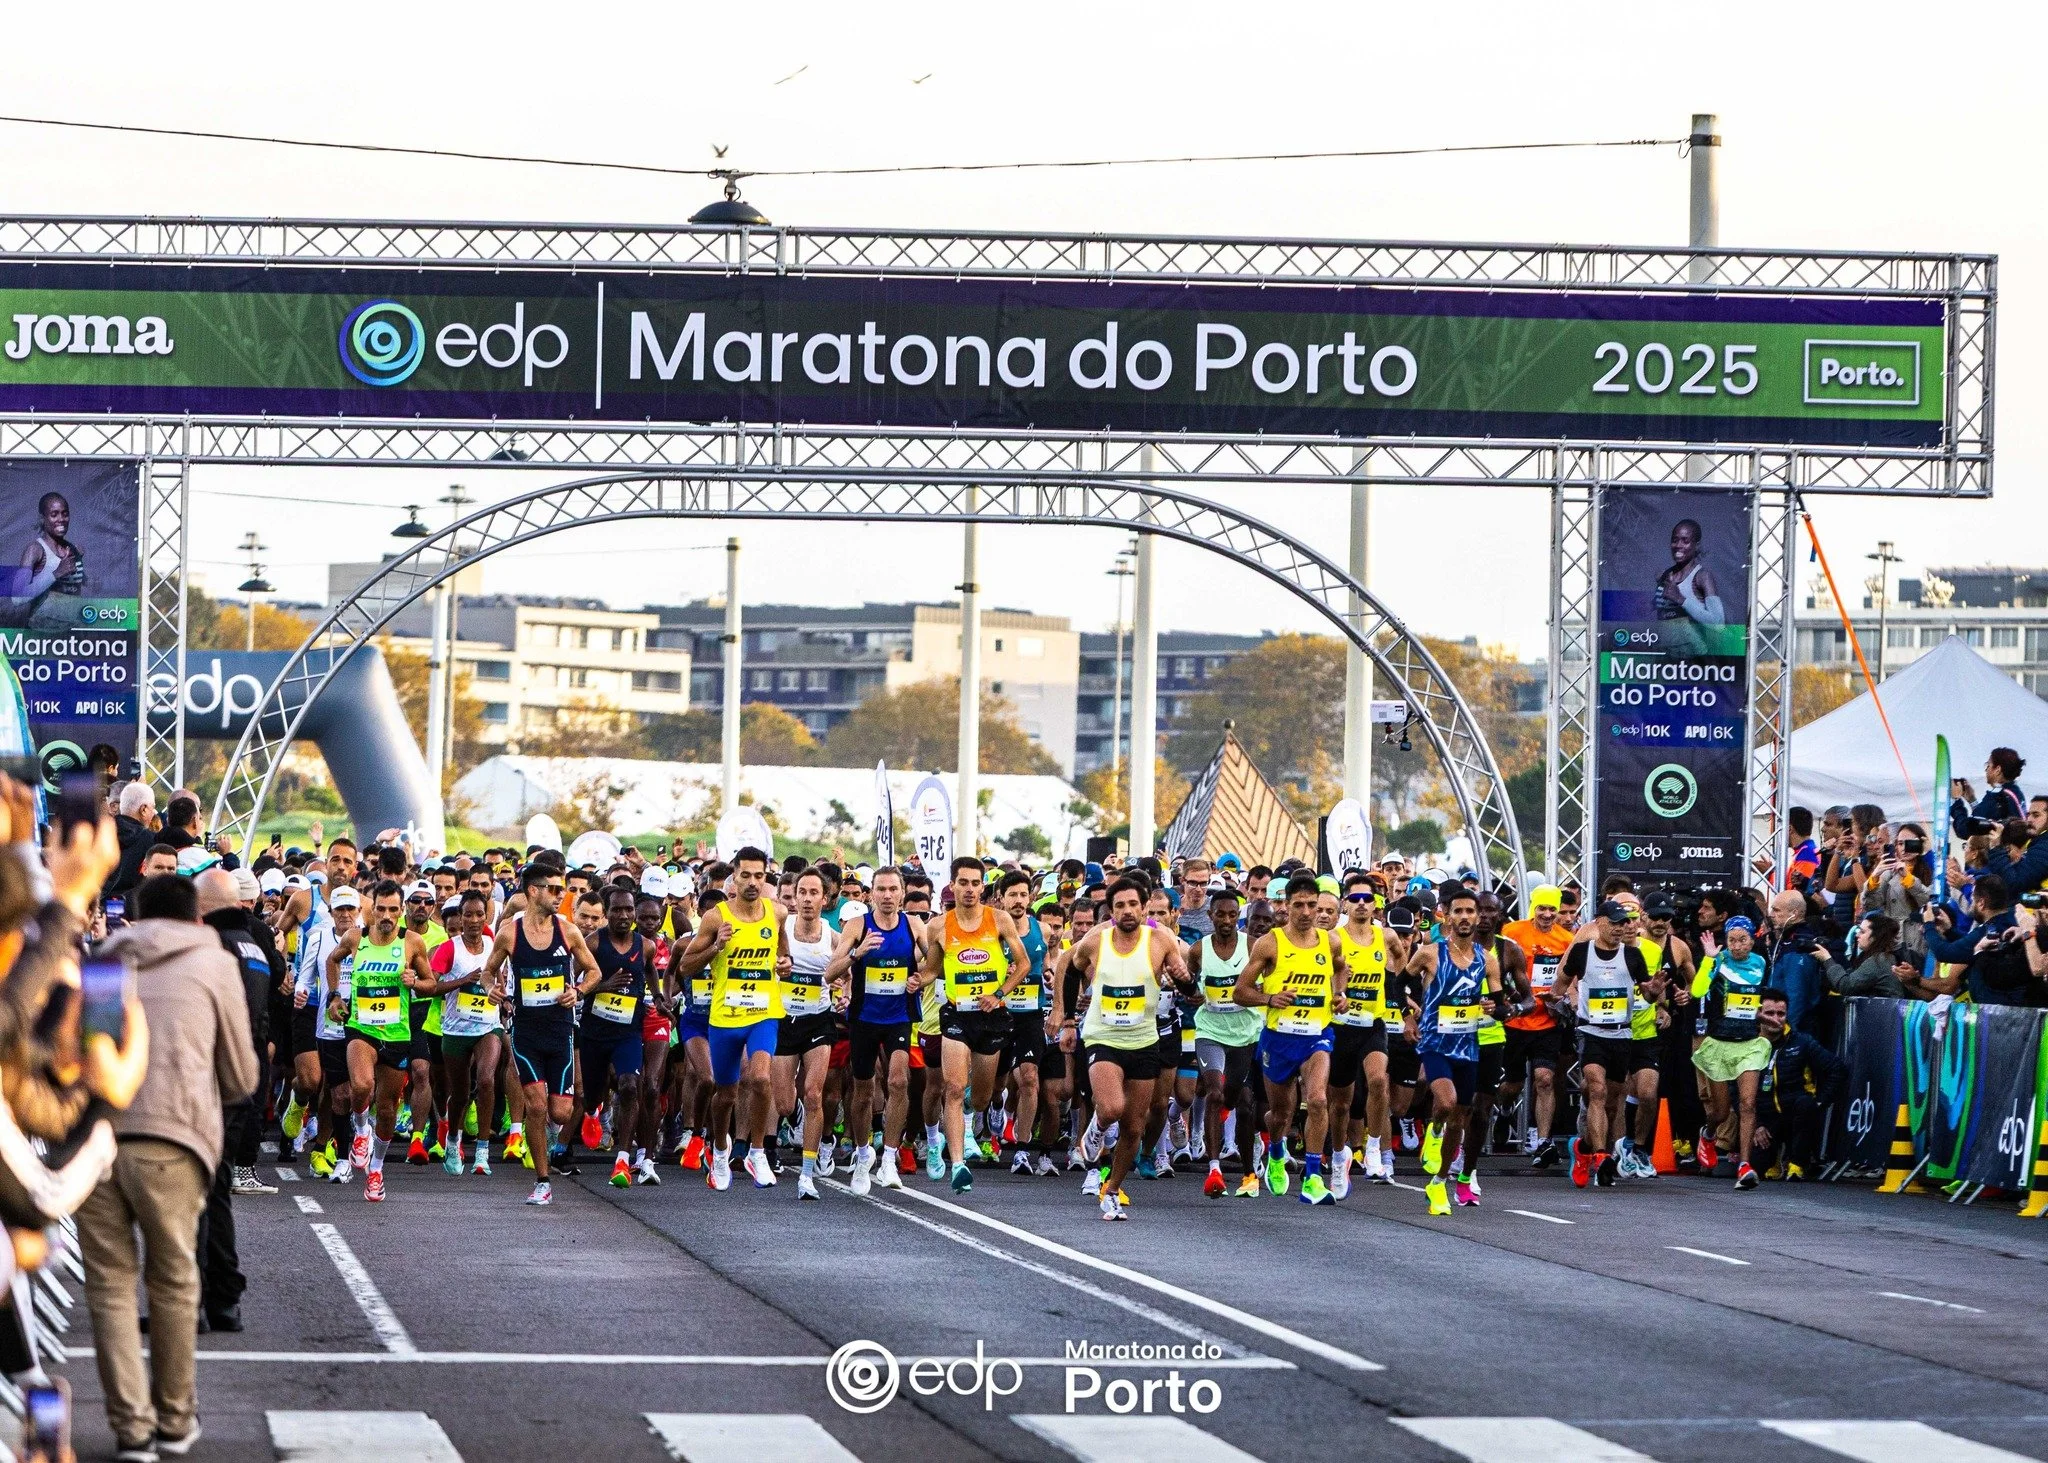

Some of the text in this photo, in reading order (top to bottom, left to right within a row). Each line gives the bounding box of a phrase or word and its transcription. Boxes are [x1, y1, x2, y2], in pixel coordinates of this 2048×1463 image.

[435, 301, 1418, 397] edp Maratona do Porto
[1592, 341, 1759, 396] 2025
[1820, 358, 1905, 387] Porto.
[99, 605, 128, 623] edp
[1630, 629, 1658, 646] edp
[0, 632, 128, 657] Maratona
[17, 660, 127, 683] do Porto
[1610, 656, 1736, 682] Maratona
[146, 658, 264, 730] edp
[1610, 683, 1717, 707] do Porto
[34, 700, 61, 714] 10K
[75, 701, 126, 715] APO 6K
[1622, 724, 1671, 738] edp 10K
[1684, 725, 1734, 739] APO 6K
[1633, 843, 1662, 861] edp
[727, 946, 771, 959] jmm
[960, 951, 988, 961] Serrano
[357, 960, 399, 972] jmm
[886, 959, 899, 967] edp
[748, 971, 761, 979] edp
[879, 973, 894, 982] 35
[974, 974, 987, 982] edp
[1283, 971, 1326, 985] jmm
[740, 982, 756, 991] 44
[1221, 977, 1235, 986] edp
[534, 983, 550, 993] 34
[791, 987, 807, 996] 42
[969, 986, 983, 995] 23
[1012, 988, 1026, 996] 95
[1221, 990, 1228, 998] 2
[1355, 991, 1369, 999] edp
[471, 998, 486, 1008] 24
[609, 997, 623, 1006] 14
[1115, 1001, 1130, 1010] 67
[1301, 997, 1316, 1006] edp
[1349, 1001, 1363, 1011] 56
[1601, 1001, 1614, 1010] 82
[1740, 997, 1753, 1006] 72
[370, 1002, 386, 1012] 49
[1293, 1009, 1310, 1019] 47
[1454, 1009, 1467, 1018] 16
